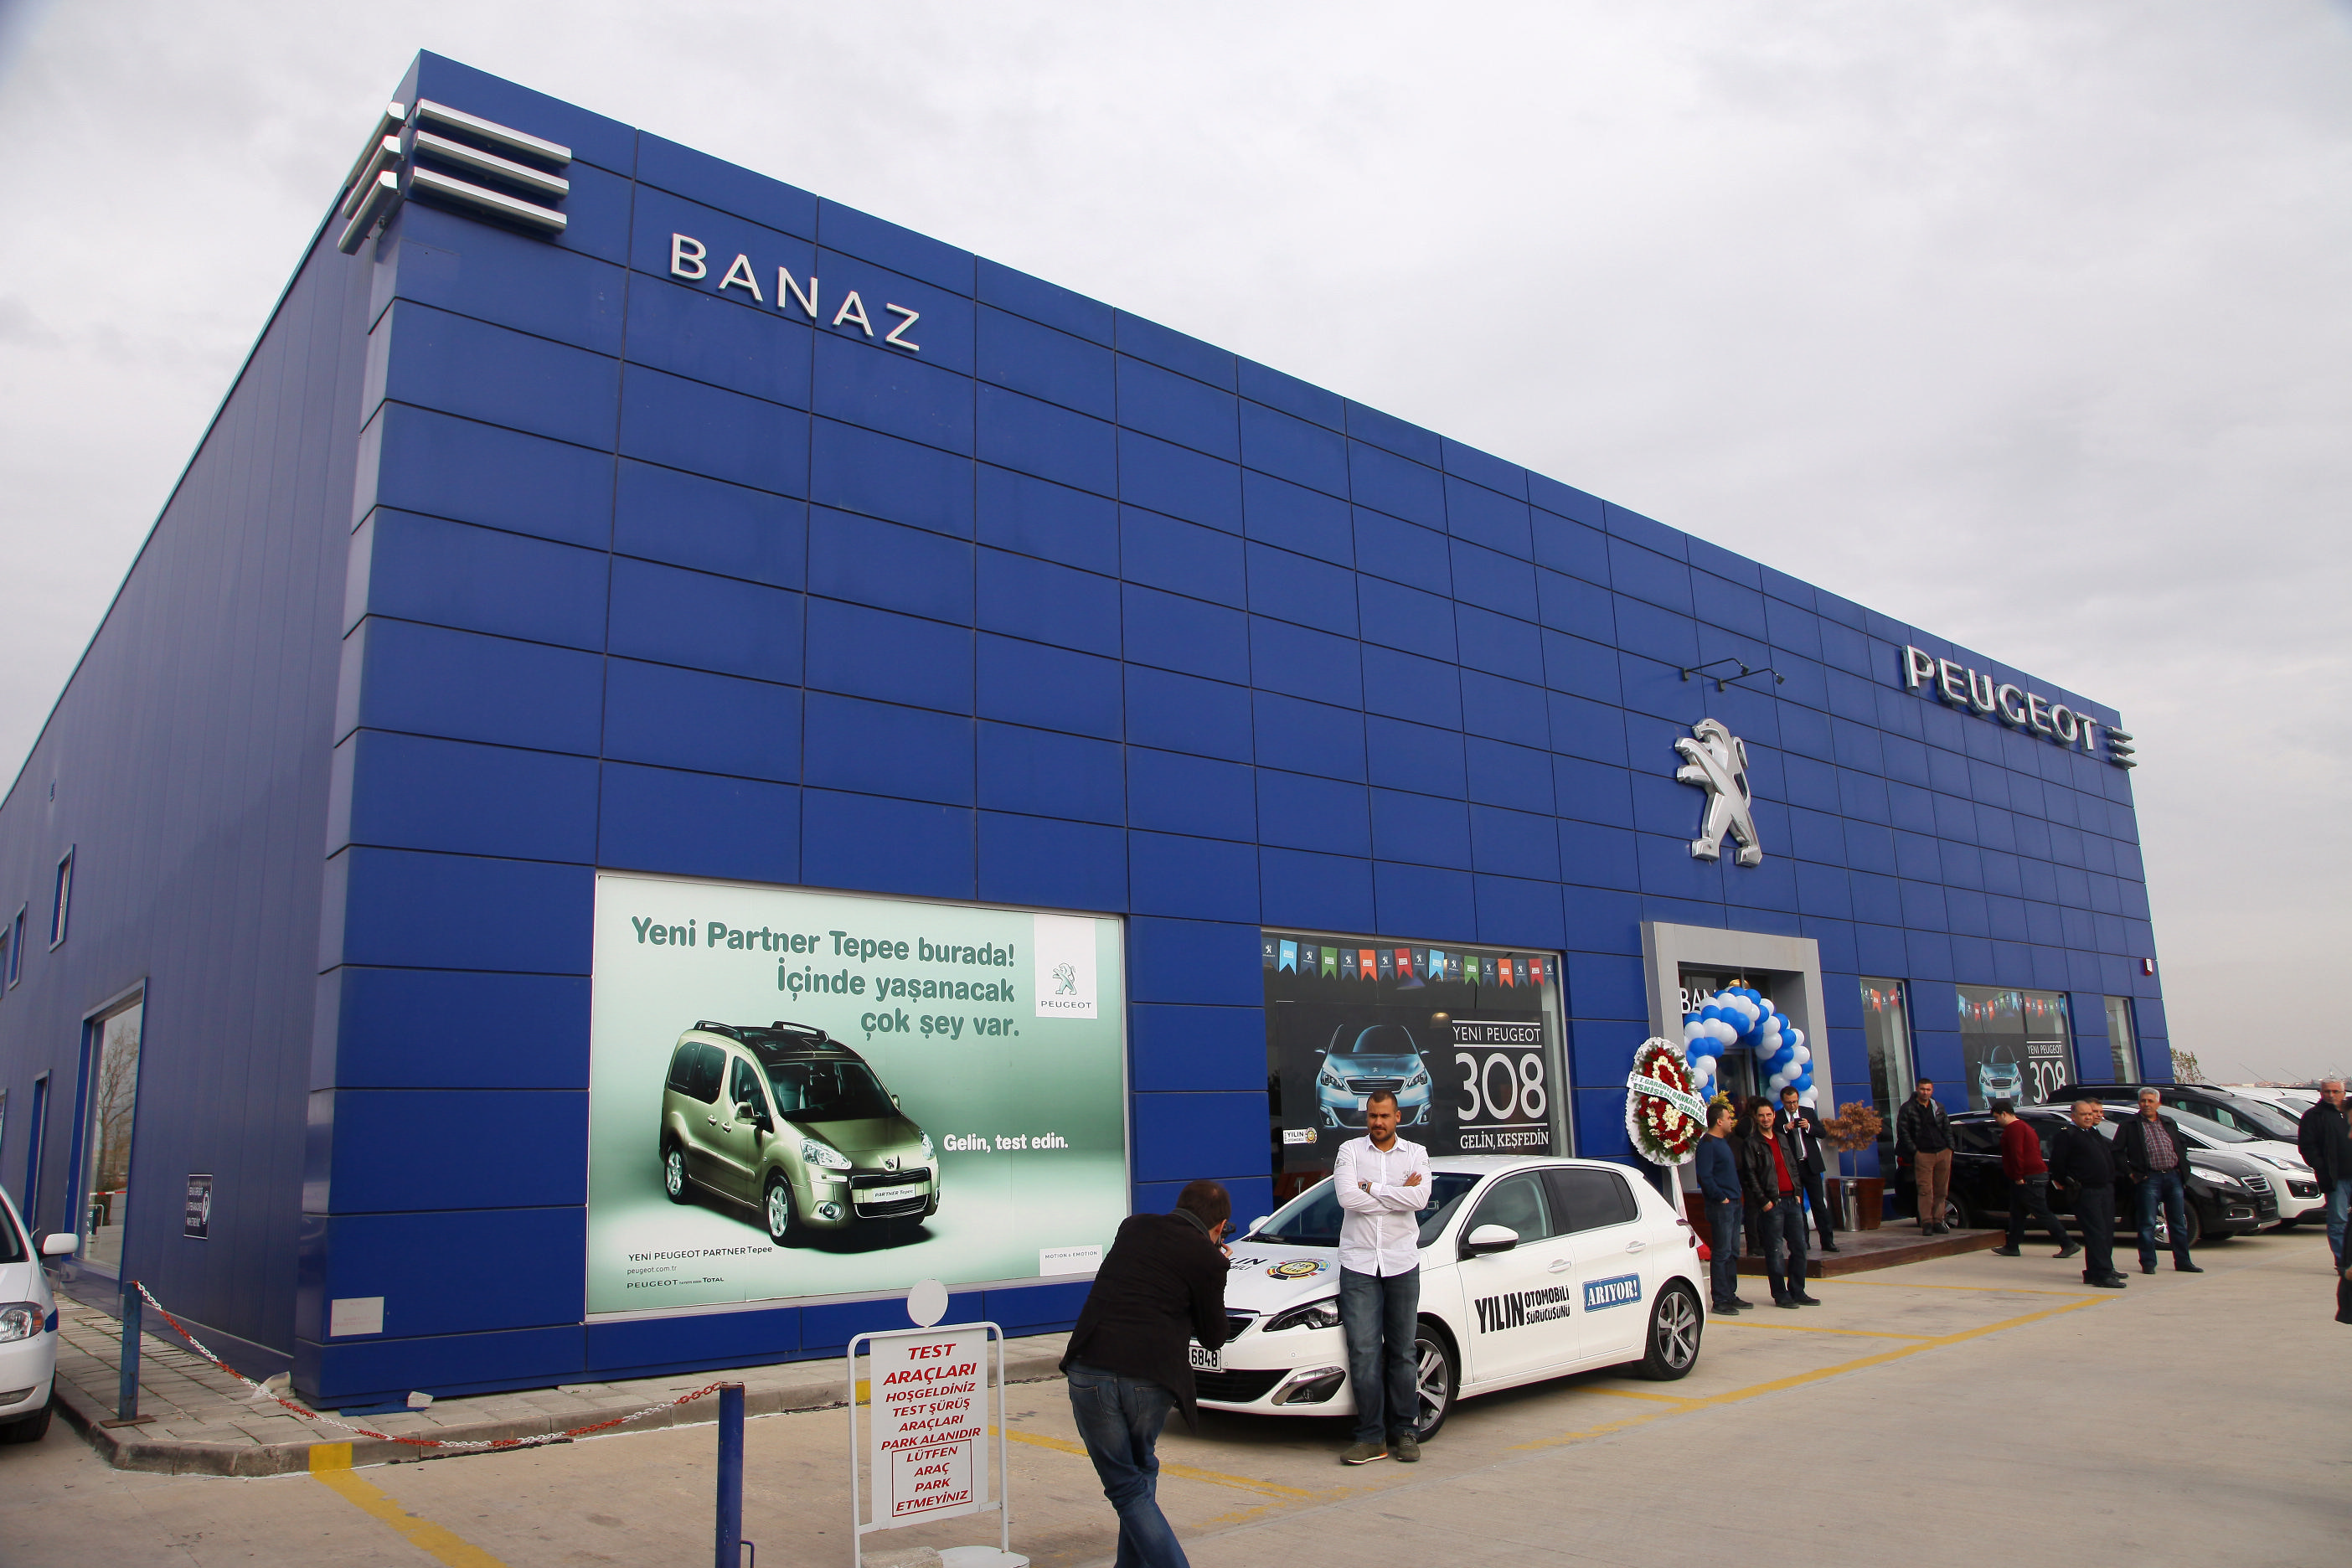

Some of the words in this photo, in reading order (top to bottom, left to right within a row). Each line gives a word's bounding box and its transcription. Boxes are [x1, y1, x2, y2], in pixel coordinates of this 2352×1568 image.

[671, 233, 920, 351] BANAZ
[1902, 645, 2097, 751] PEUGEOT
[632, 916, 696, 947] Yeni
[708, 921, 821, 954] Partner
[828, 930, 910, 963] Tepee
[918, 936, 1014, 967] burada!
[777, 957, 866, 1002] İçinde
[875, 977, 1015, 1003] yaşanacak
[1040, 1000, 1092, 1009] PEUGEOT
[1679, 987, 1717, 1014] BA
[860, 1008, 910, 1041] çok
[920, 1014, 965, 1041] şey
[972, 1017, 1019, 1037] var.
[1452, 1026, 1482, 1041] YENİ
[1487, 1027, 1541, 1042] PEUGEOT
[2040, 1044, 2062, 1055] PEUGEOT
[1455, 1052, 1546, 1121] 308
[943, 1133, 991, 1153] Gelin,
[995, 1133, 1027, 1150] test
[1031, 1132, 1070, 1149] edin.
[1460, 1131, 1496, 1150] GELİN,
[1497, 1128, 1550, 1149] KEŞFEDİN
[628, 1251, 652, 1261] YENİ
[654, 1250, 700, 1261] PEUGEOT
[703, 1247, 746, 1257] PARTNER
[747, 1246, 773, 1255] Tepee
[627, 1266, 678, 1276] peugeot.com.tr
[627, 1279, 678, 1289] PEUGEOT
[1586, 1279, 1639, 1307] ARIYOR!
[1474, 1292, 1524, 1334] YILIN
[1524, 1285, 1570, 1308] OTOMOBİLİ
[1526, 1304, 1571, 1325] SÜRÜCÜSÜNÜ
[908, 1343, 957, 1360] TEST
[1191, 1349, 1218, 1368] 6848
[882, 1363, 977, 1386] ARAÇLARI
[885, 1381, 976, 1403] HOŞGELDİNİZ
[893, 1404, 927, 1417] TEST
[898, 1414, 964, 1433] ARAÇLARI
[881, 1436, 919, 1451] PARK
[920, 1427, 981, 1445] ALANIDIR
[906, 1446, 958, 1462] LÜTFEN
[914, 1462, 951, 1478] ARAÇ
[915, 1478, 952, 1493] PARK
